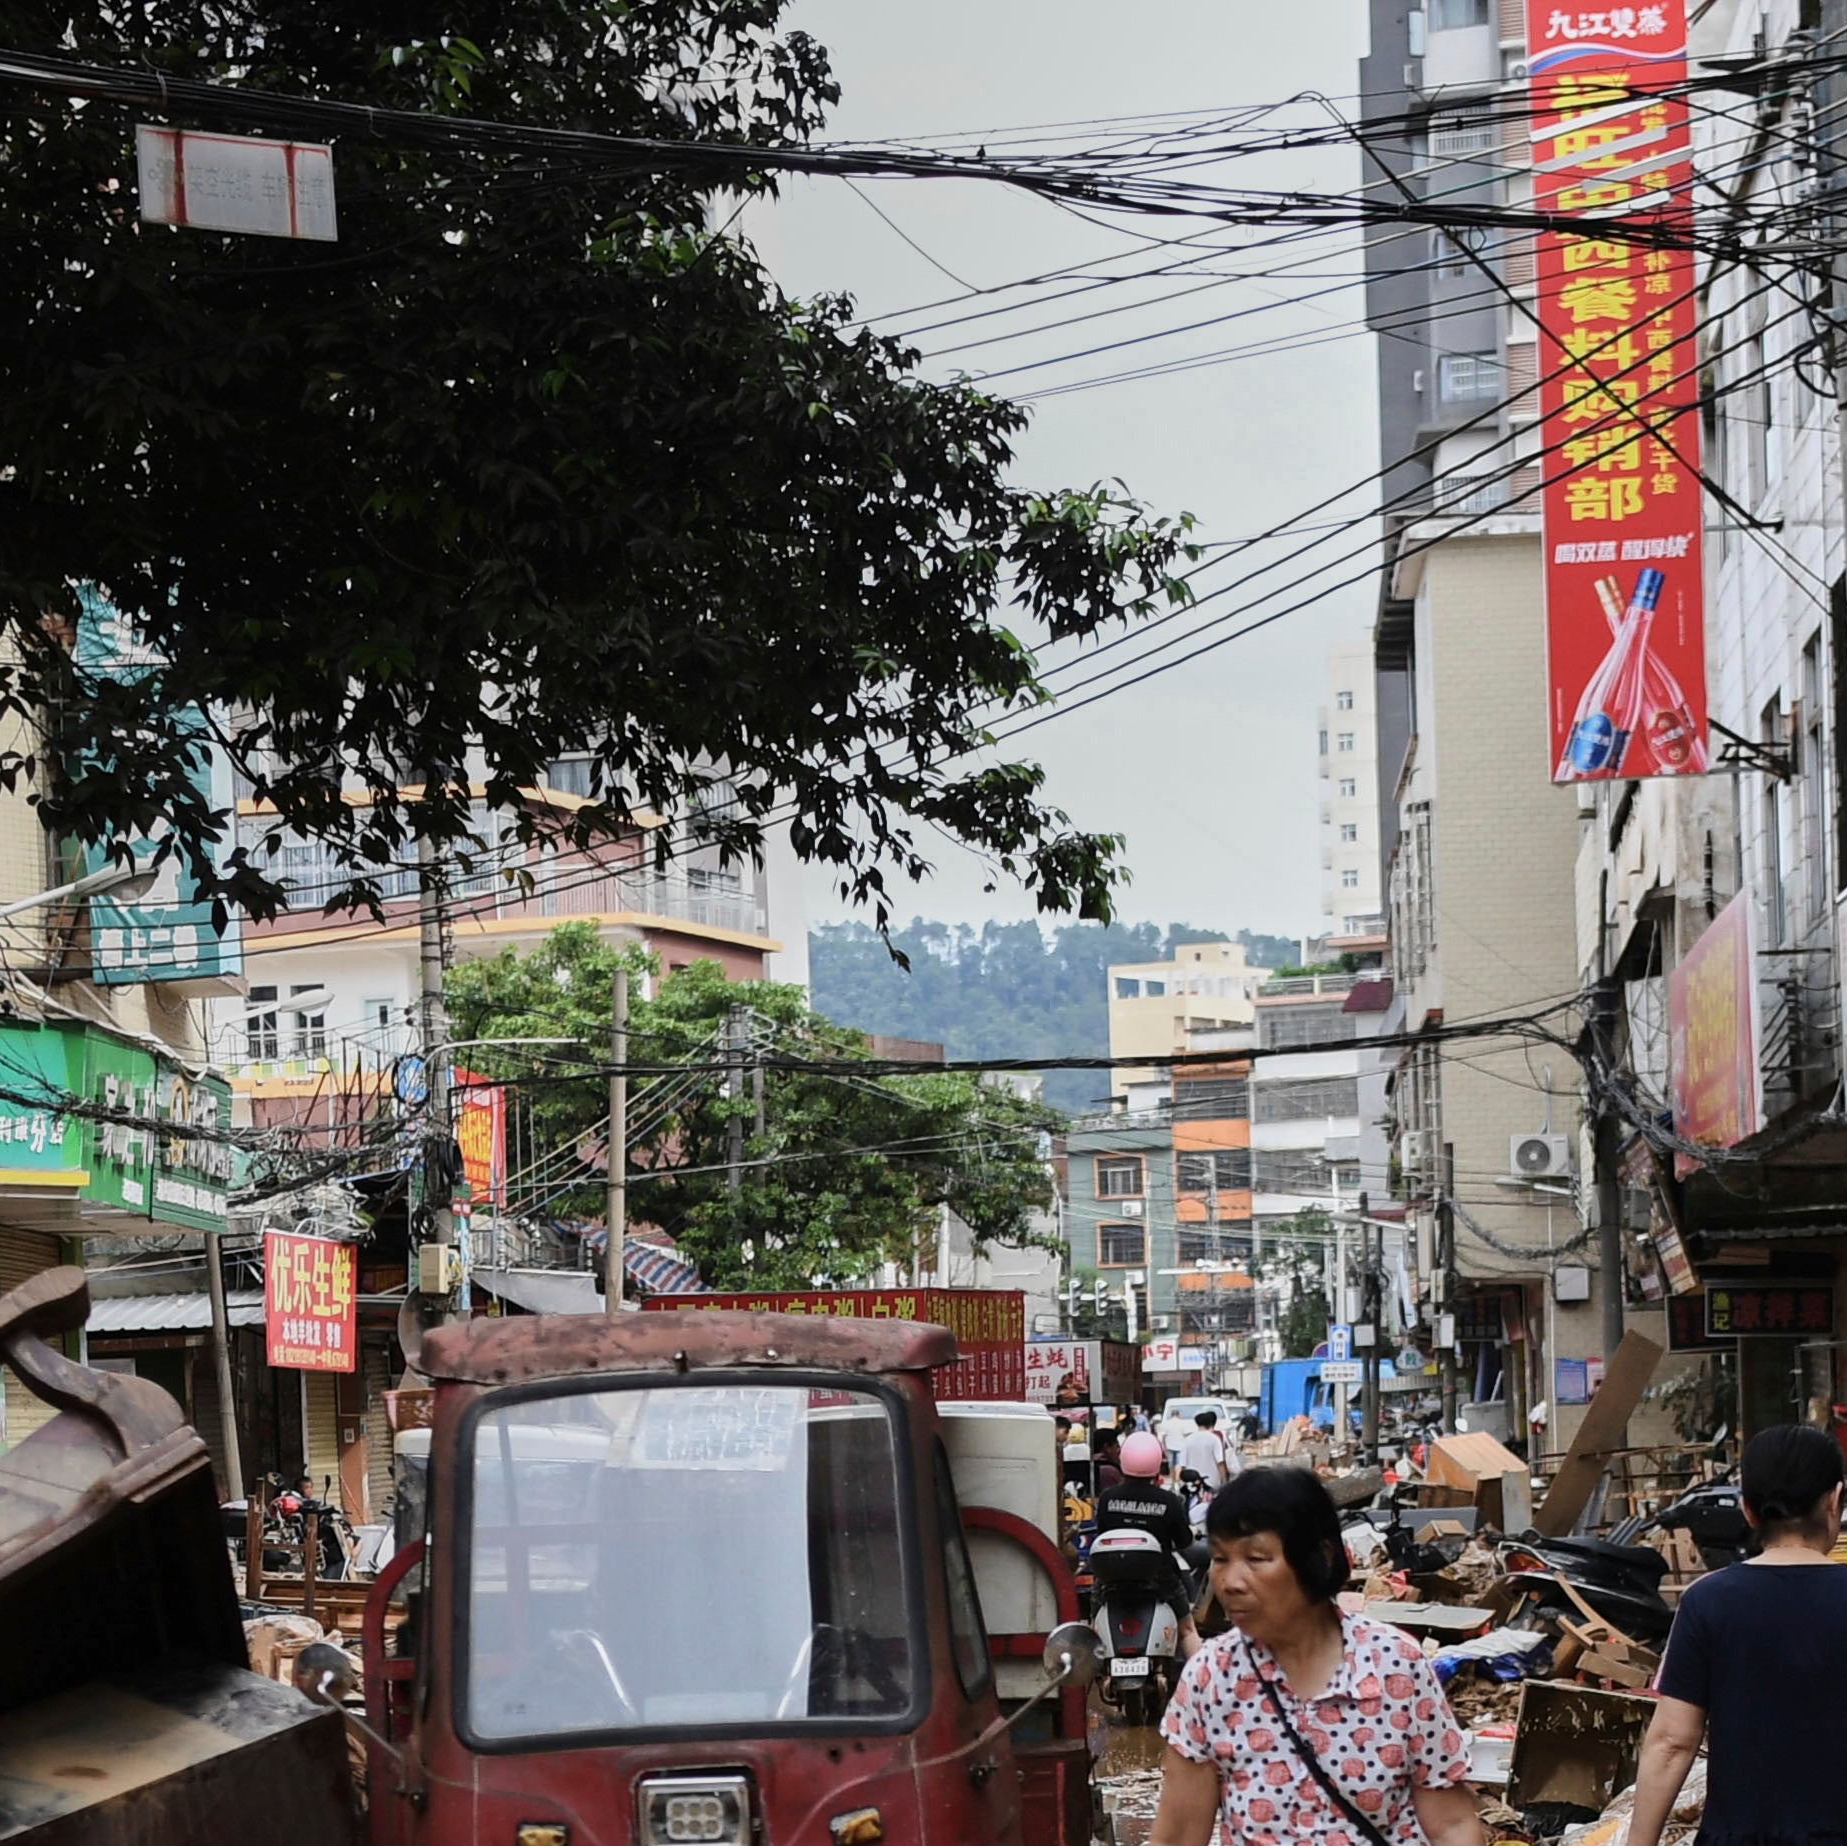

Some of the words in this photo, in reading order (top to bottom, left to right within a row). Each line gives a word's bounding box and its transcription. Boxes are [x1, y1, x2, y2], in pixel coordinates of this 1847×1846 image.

[269, 1237, 352, 1322] 优乐生鲜
[1027, 1347, 1068, 1370] 生蚝
